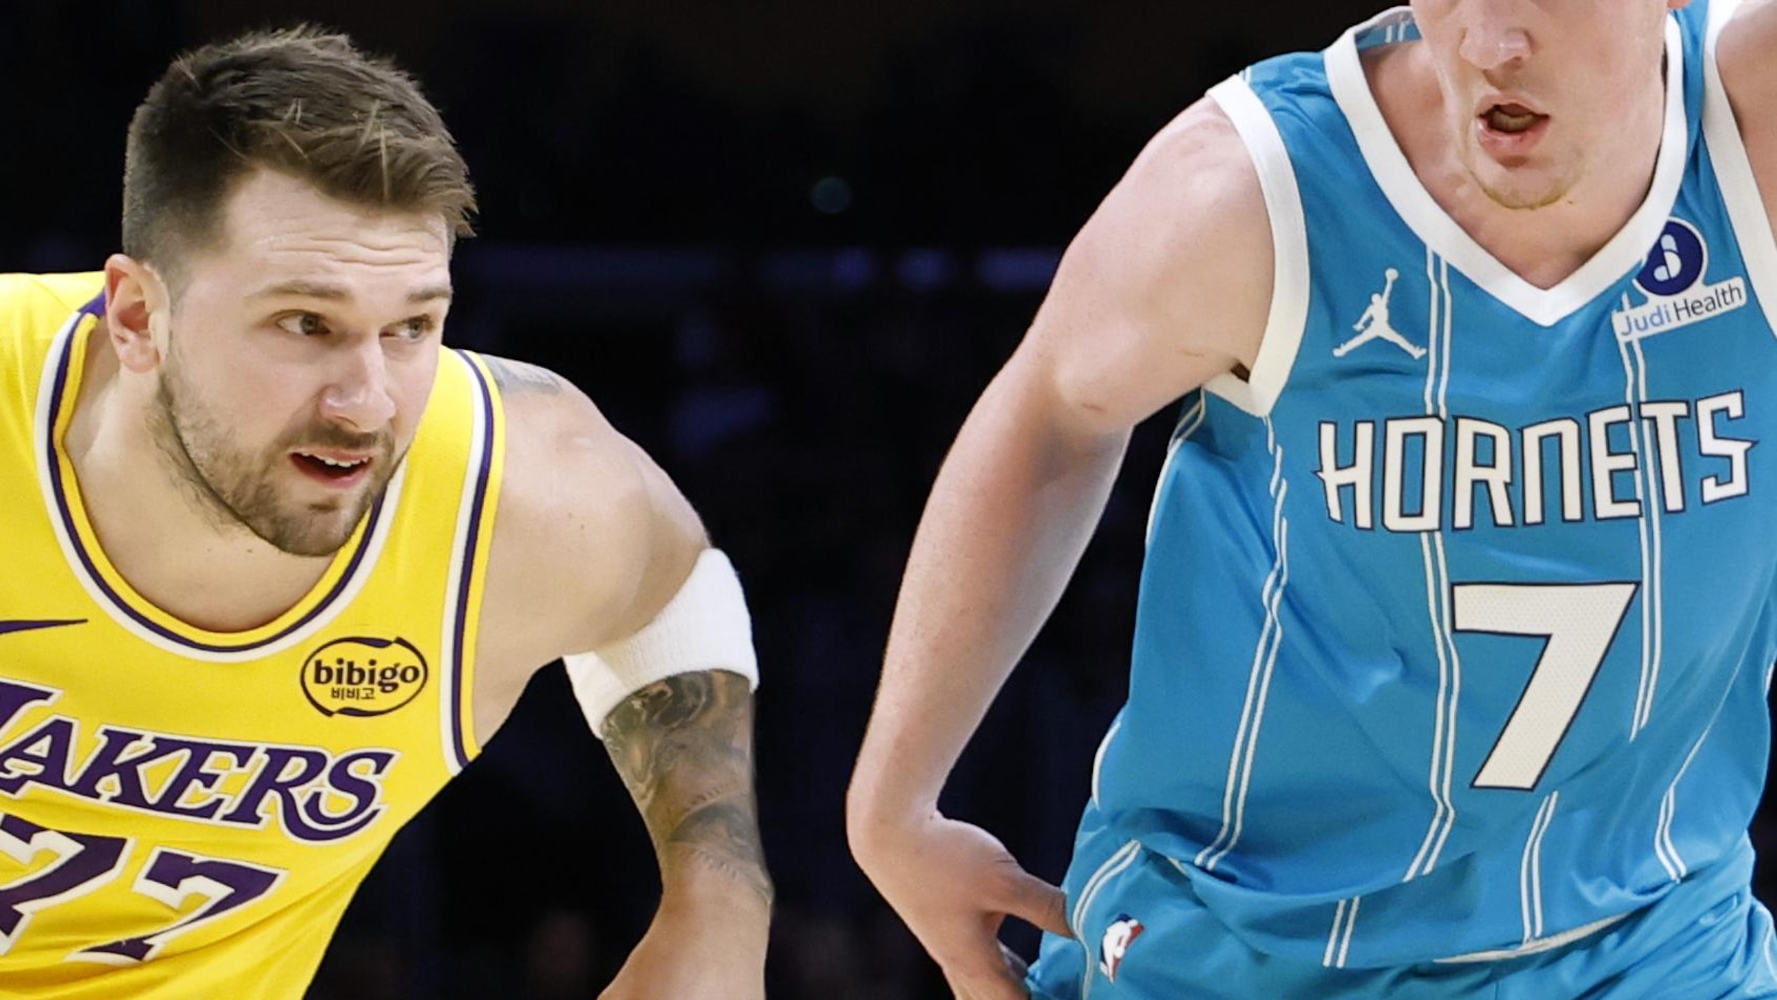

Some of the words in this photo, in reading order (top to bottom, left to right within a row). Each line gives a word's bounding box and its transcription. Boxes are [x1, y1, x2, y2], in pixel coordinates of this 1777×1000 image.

[1621, 304, 1672, 336] Judi
[1673, 283, 1742, 321] Health
[1312, 388, 1759, 533] HORNETS
[313, 657, 420, 694] bibigo
[330, 687, 376, 701] 비비고
[1451, 581, 1642, 791] 7
